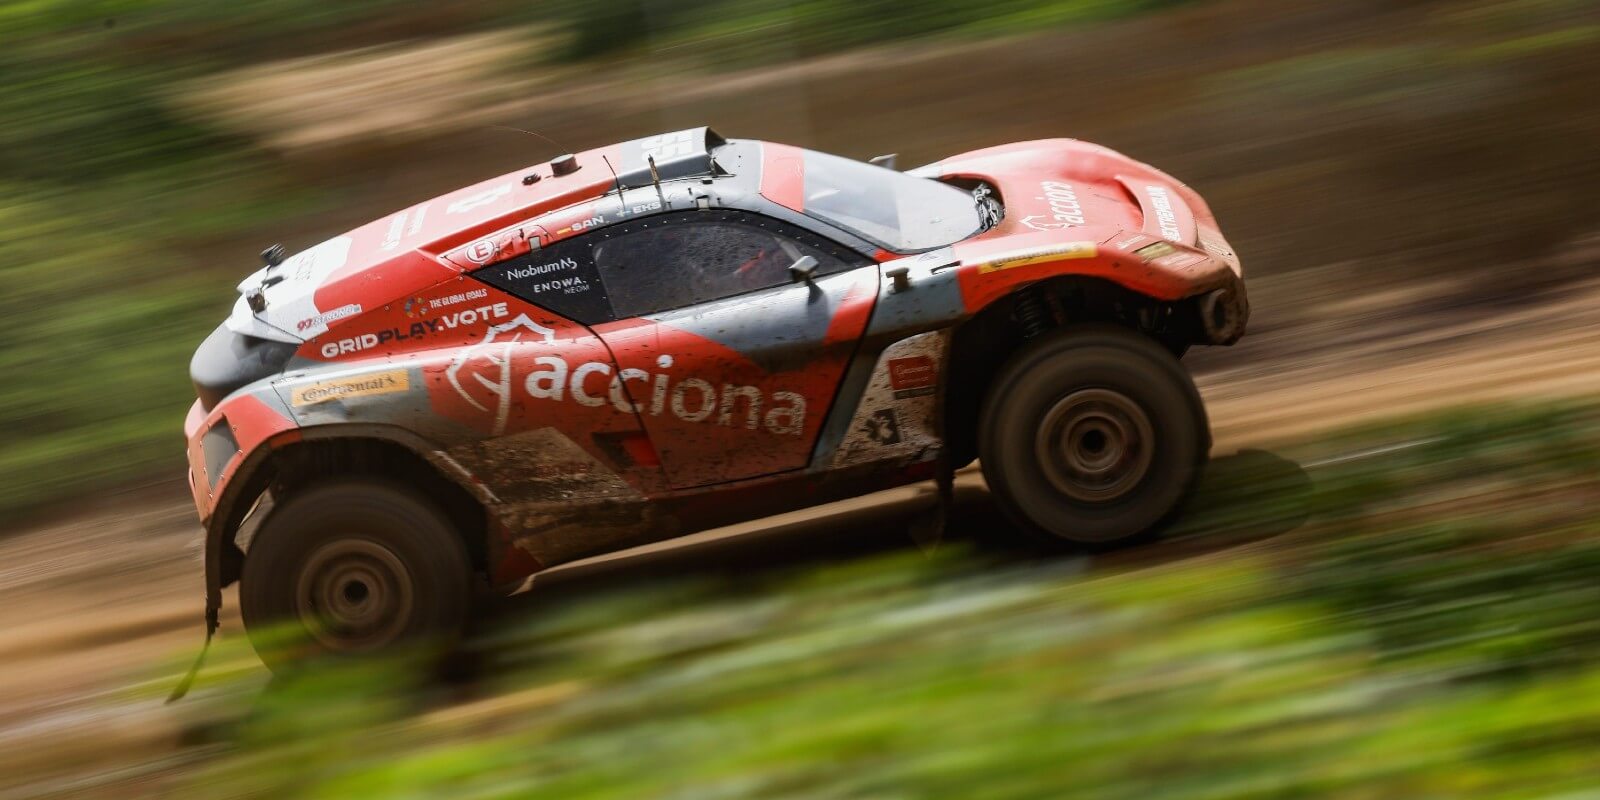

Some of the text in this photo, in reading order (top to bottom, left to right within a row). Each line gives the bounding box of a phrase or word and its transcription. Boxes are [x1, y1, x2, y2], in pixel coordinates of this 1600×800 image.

[632, 202, 661, 214] EKS
[475, 244, 489, 259] E
[564, 284, 590, 295] NEOM
[429, 288, 488, 309] THE GLOBAL GOALS
[524, 354, 806, 436] acciona
